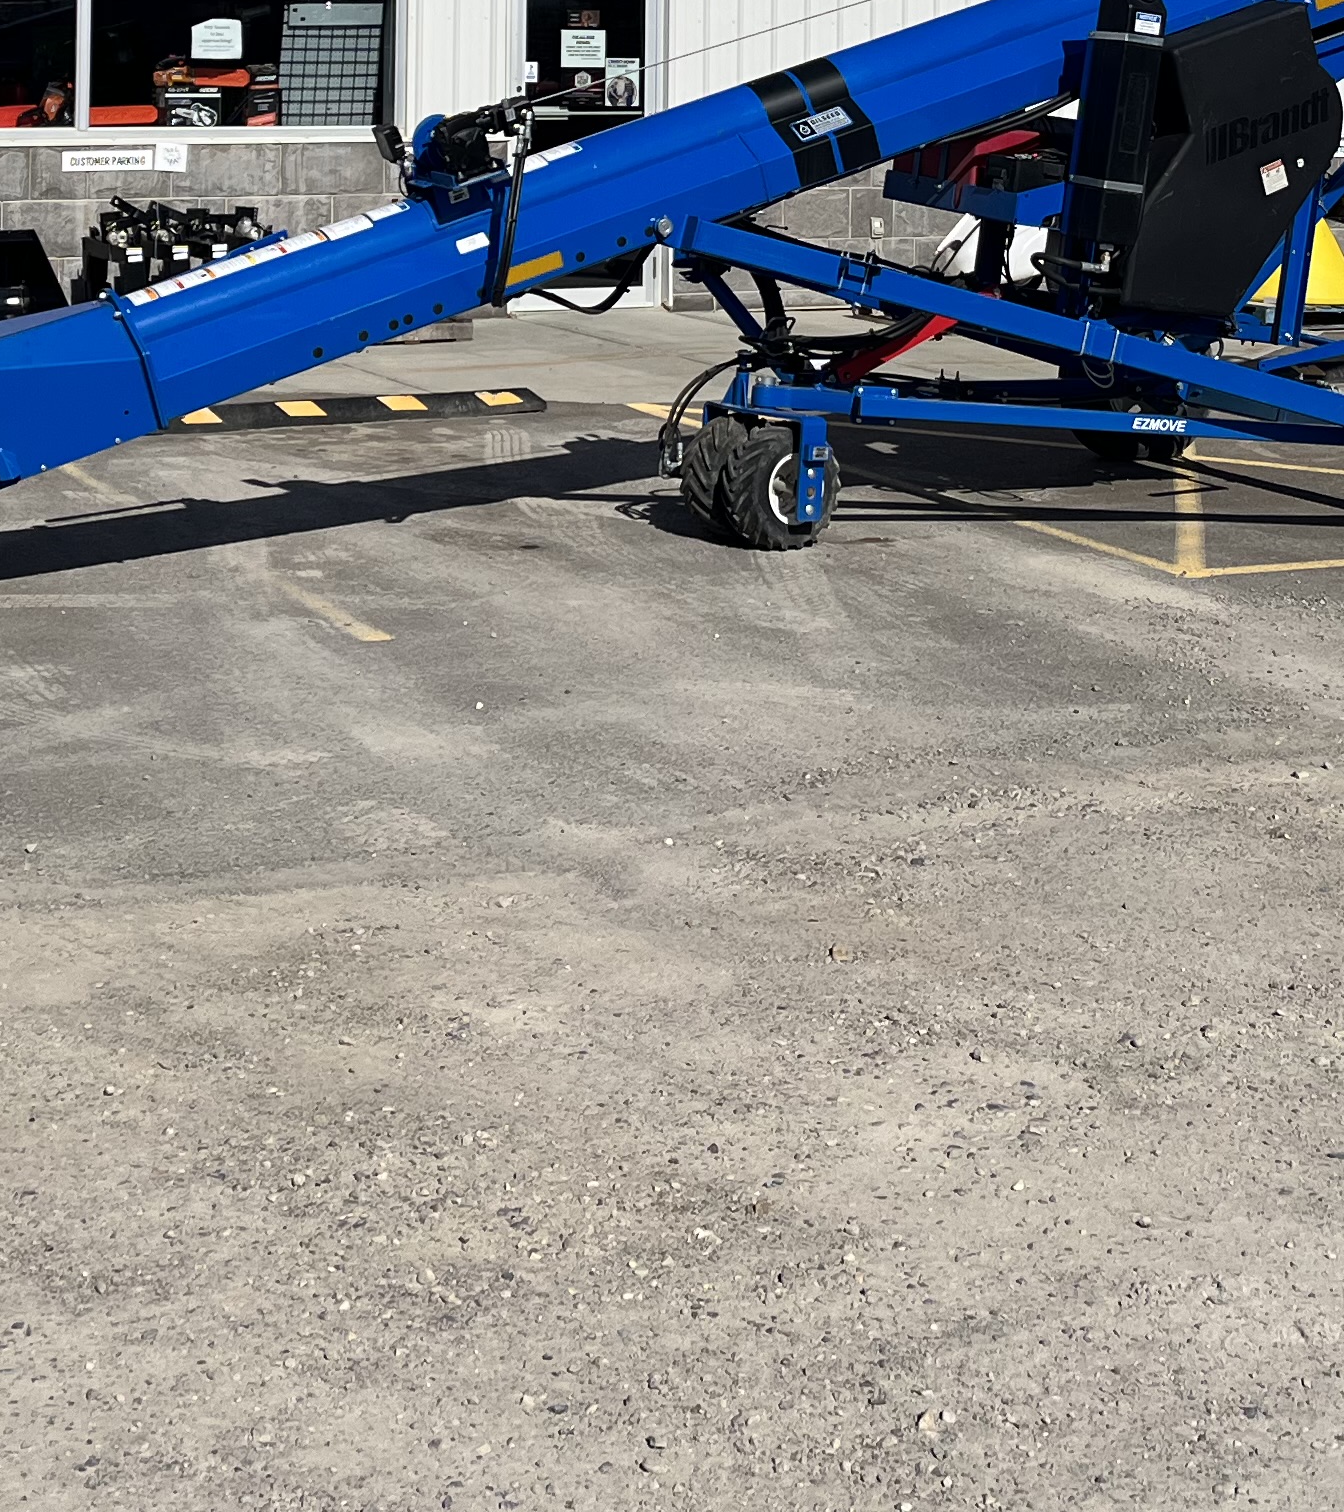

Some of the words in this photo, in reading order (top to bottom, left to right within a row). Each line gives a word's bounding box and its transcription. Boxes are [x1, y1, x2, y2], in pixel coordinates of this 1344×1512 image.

[1228, 87, 1331, 158] Brandt
[69, 157, 111, 167] CUSTOMER
[111, 156, 146, 166] PARKING
[1132, 417, 1187, 433] EZMOVE
